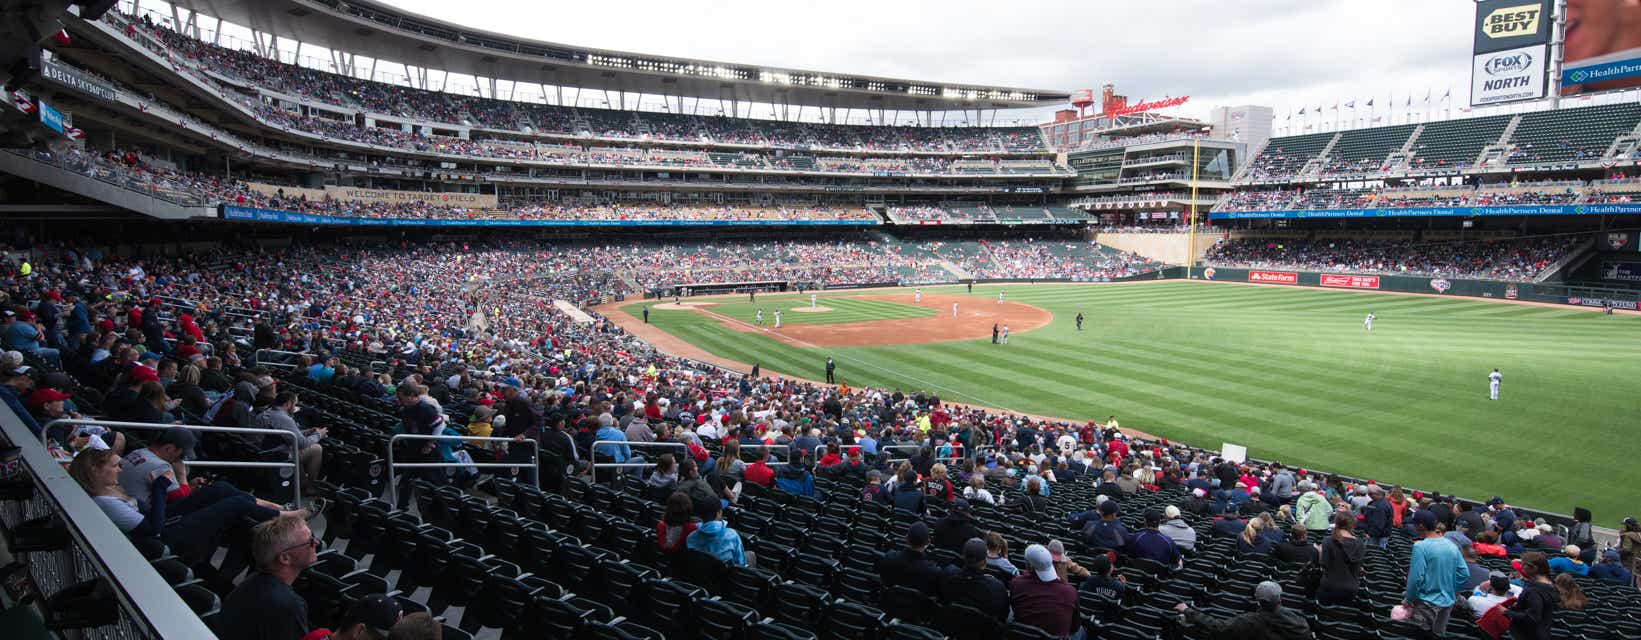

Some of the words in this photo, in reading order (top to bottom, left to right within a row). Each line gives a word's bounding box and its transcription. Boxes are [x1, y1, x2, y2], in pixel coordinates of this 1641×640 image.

[1490, 10, 1539, 25] BEST
[1490, 20, 1533, 34] BUY
[1494, 55, 1522, 68] FOX
[51, 68, 77, 87] DELTA
[1484, 76, 1530, 91] NORTH
[1107, 95, 1190, 119] Budweiser
[346, 190, 392, 200] WELCOME
[407, 193, 441, 202] TARGET
[449, 194, 475, 203] FIELD
[1064, 441, 1071, 450] 5
